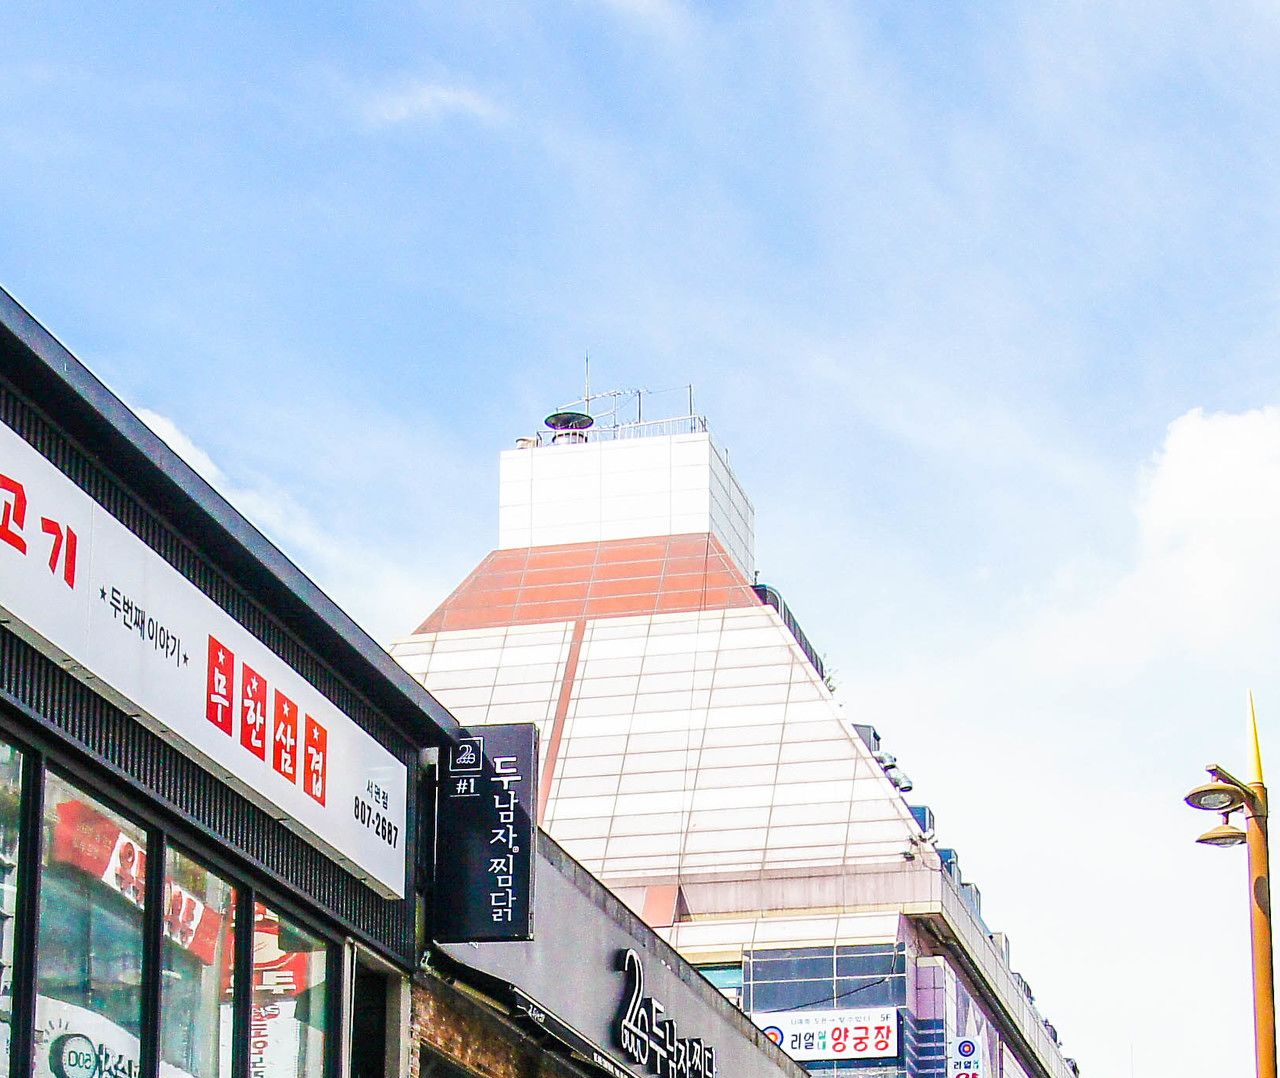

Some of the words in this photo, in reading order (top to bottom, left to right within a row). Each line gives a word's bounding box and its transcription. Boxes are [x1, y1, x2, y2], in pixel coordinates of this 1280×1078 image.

[109, 586, 145, 641] 두번째
[148, 617, 181, 669] 이야기
[209, 664, 327, 803] 무한삼겹
[352, 795, 399, 850] 807-2687
[366, 779, 389, 812] 서면점
[790, 1032, 815, 1050] 리얼
[831, 1025, 892, 1053] 양궁장
